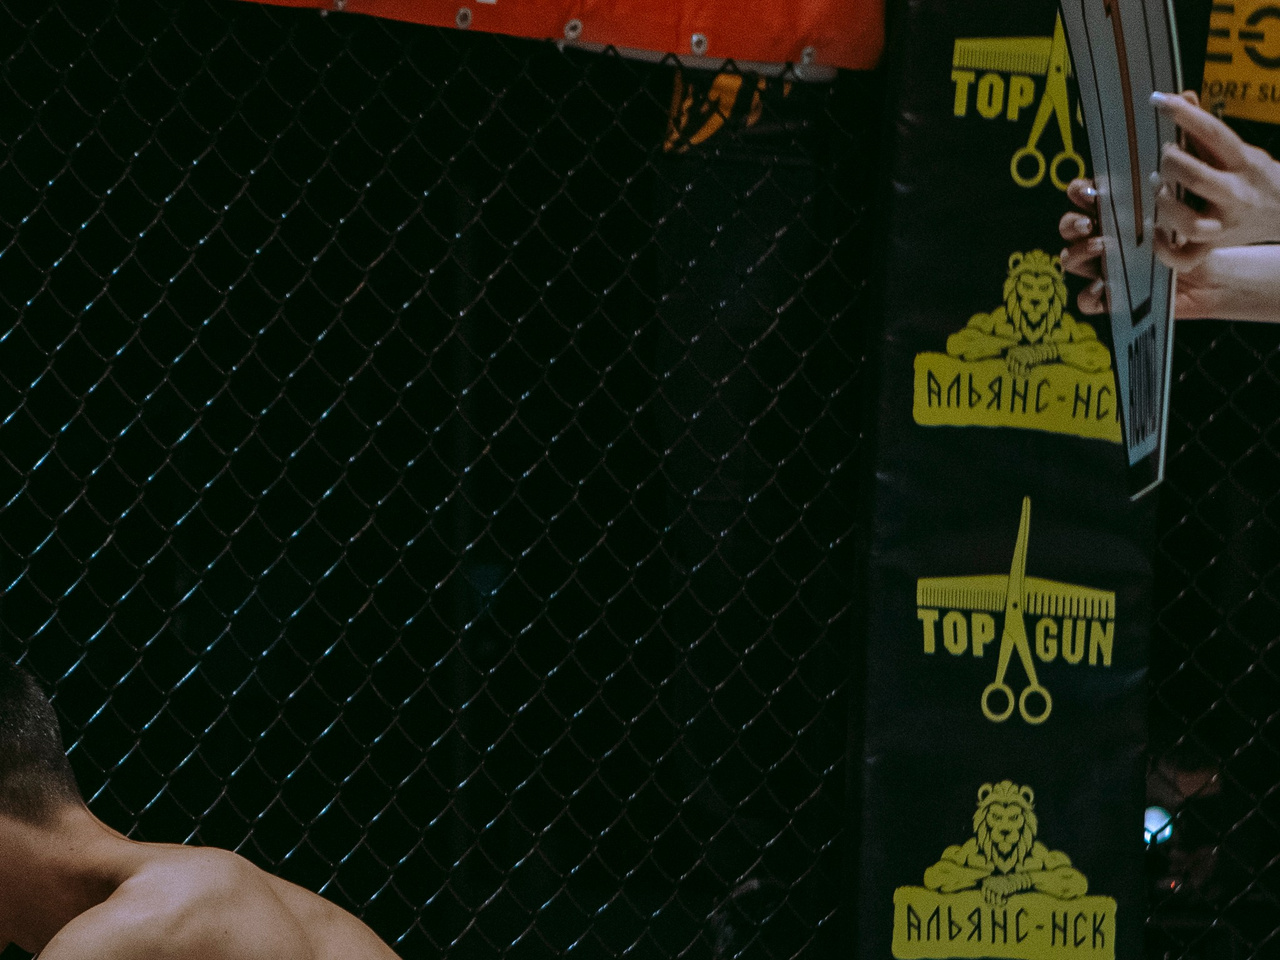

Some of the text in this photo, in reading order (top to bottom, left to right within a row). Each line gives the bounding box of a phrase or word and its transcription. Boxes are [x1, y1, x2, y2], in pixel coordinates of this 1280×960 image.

[951, 69, 1036, 122] TOP
[926, 369, 1122, 423] АЛЬЯНС-НС
[917, 607, 1116, 667] TOP GUN
[906, 903, 1106, 949] АЛЬЯНС-НСК
